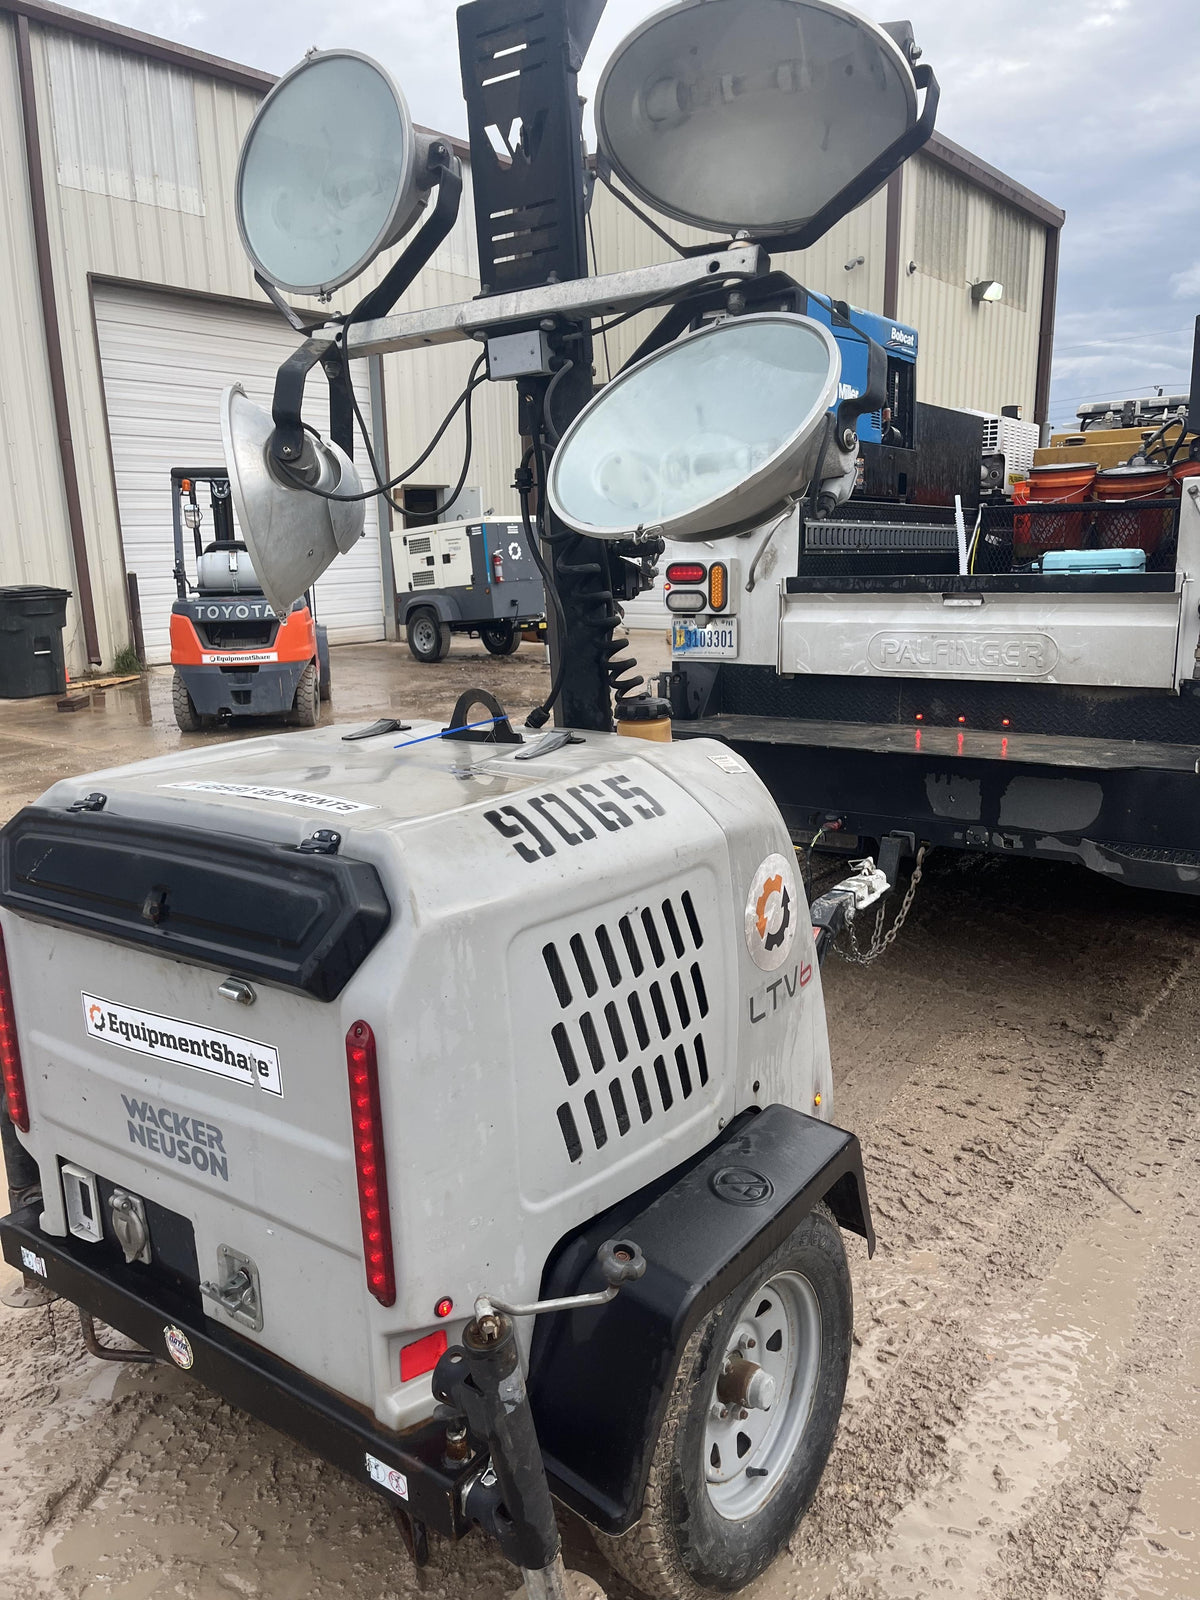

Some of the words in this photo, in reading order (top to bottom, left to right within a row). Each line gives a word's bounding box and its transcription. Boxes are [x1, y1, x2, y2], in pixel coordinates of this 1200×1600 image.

[891, 326, 915, 347] Bobcat
[195, 604, 277, 619] TOYOTA
[216, 653, 271, 663] EquipmentShare
[879, 638, 1045, 668] PALFINGER
[482, 774, 667, 864] 9065
[749, 960, 812, 1024] LTV6
[120, 1093, 227, 1154] WACKER
[127, 1119, 229, 1182] NEUSON
